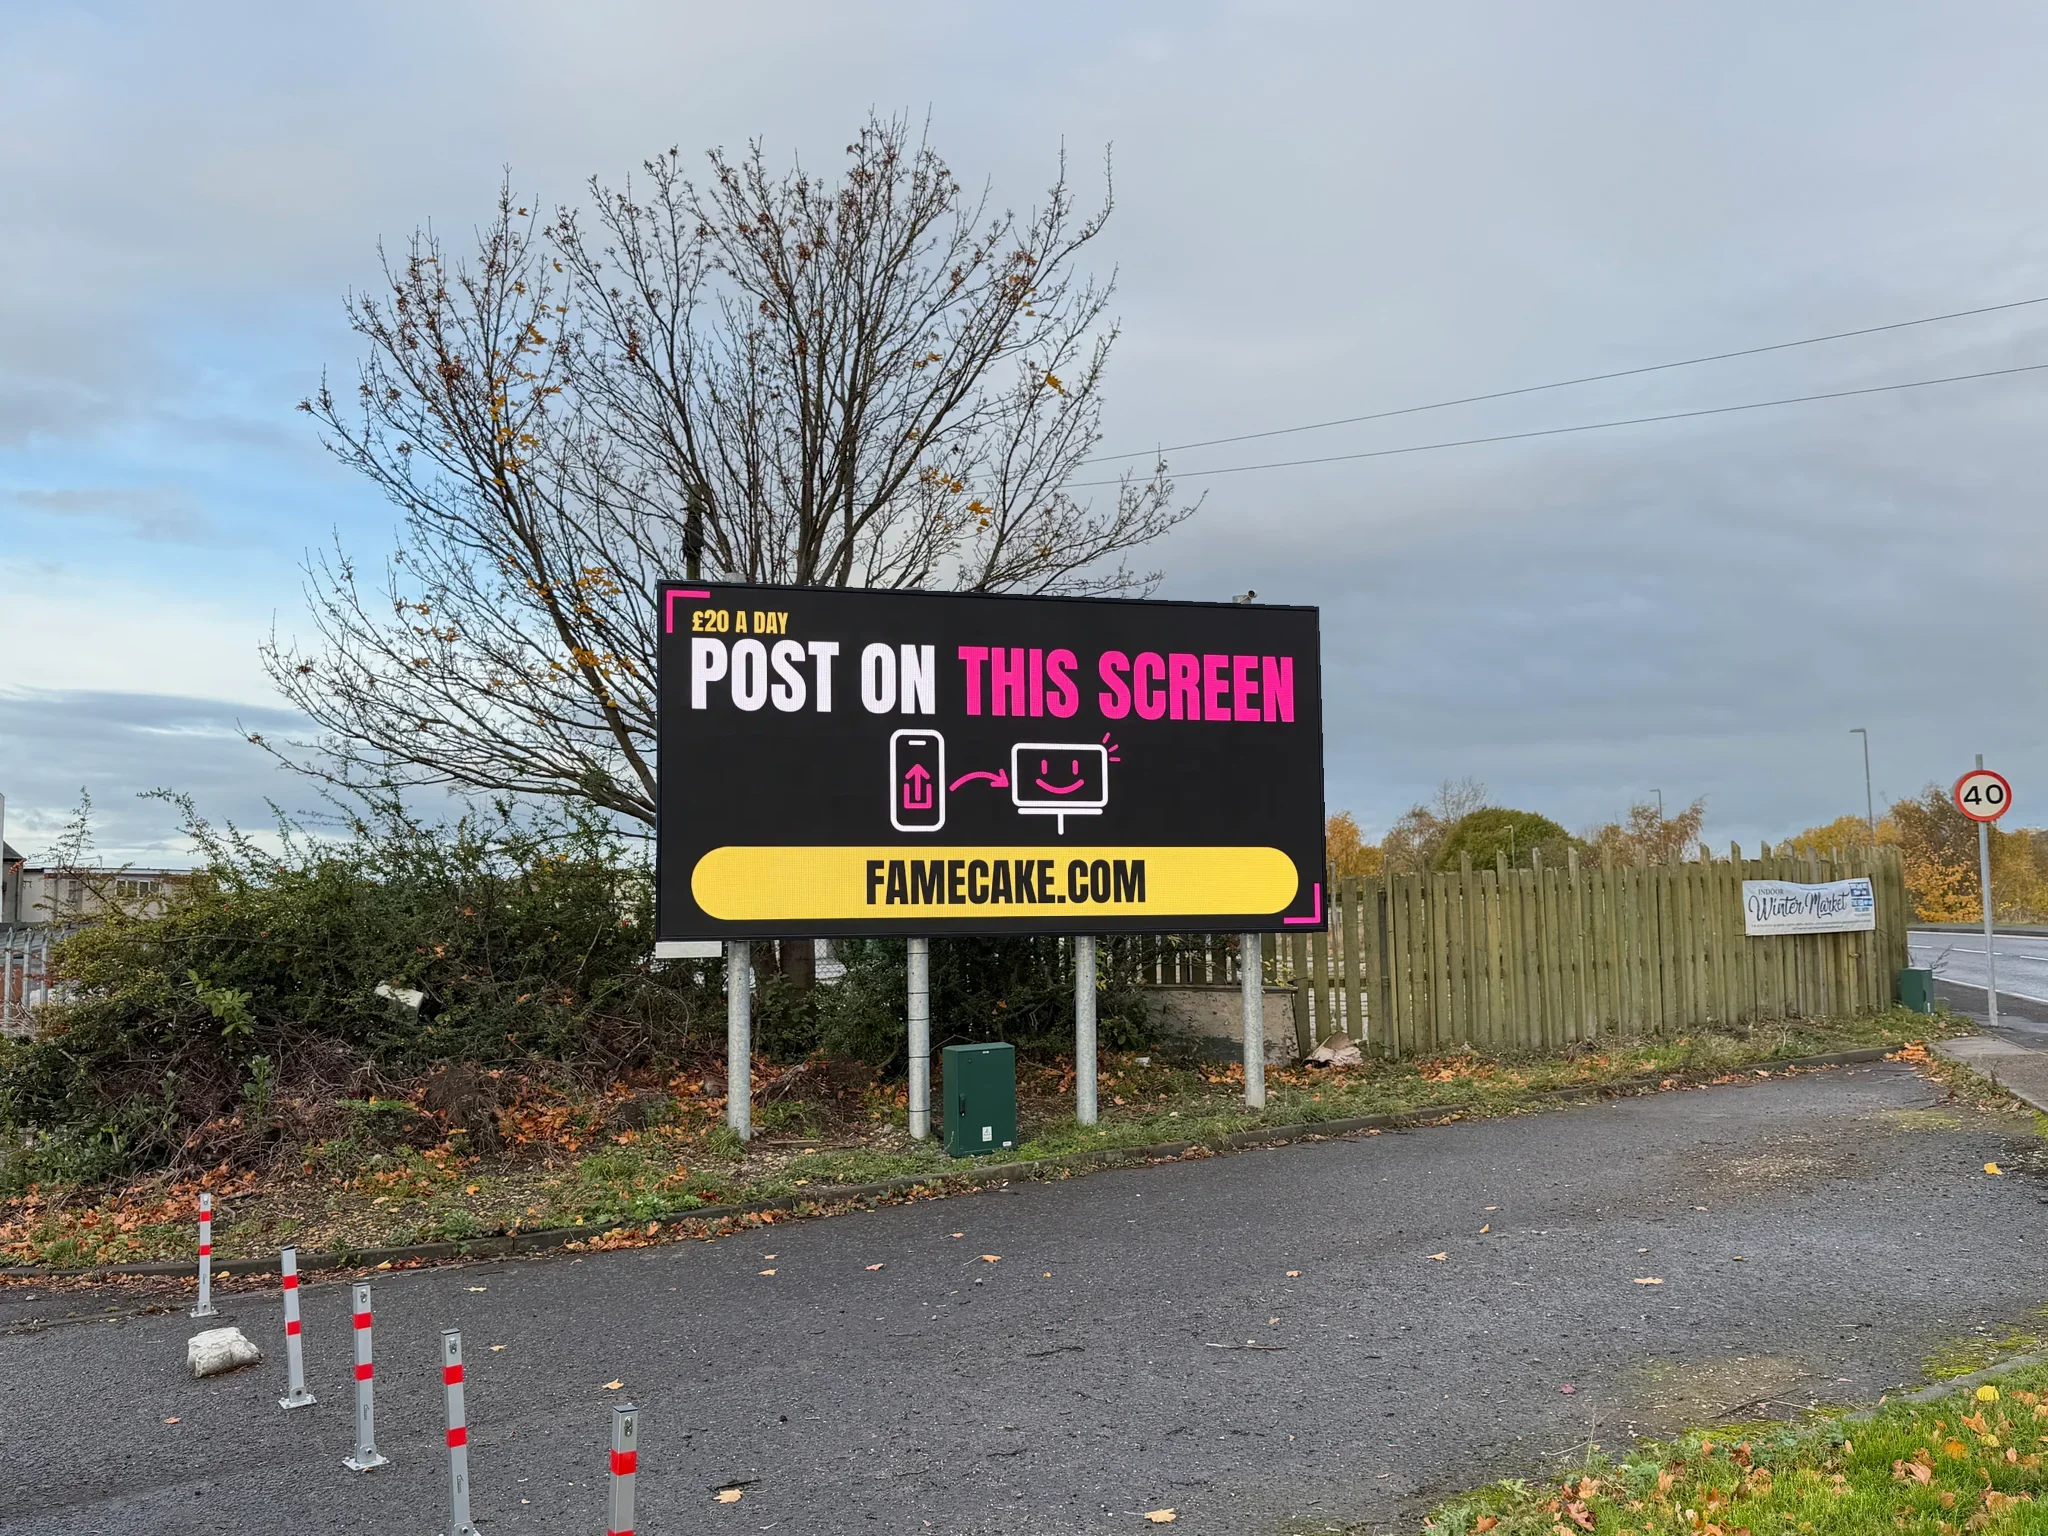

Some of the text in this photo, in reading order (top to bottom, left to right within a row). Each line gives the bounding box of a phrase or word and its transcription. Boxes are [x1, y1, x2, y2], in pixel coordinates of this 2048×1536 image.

[692, 610, 789, 634] £20 A DAY
[691, 637, 1294, 722] POST ON THIS SCREEN
[1963, 784, 2004, 805] 40
[866, 859, 1146, 905] FAMECAKE.COM
[1748, 891, 1850, 921] Winter Market
